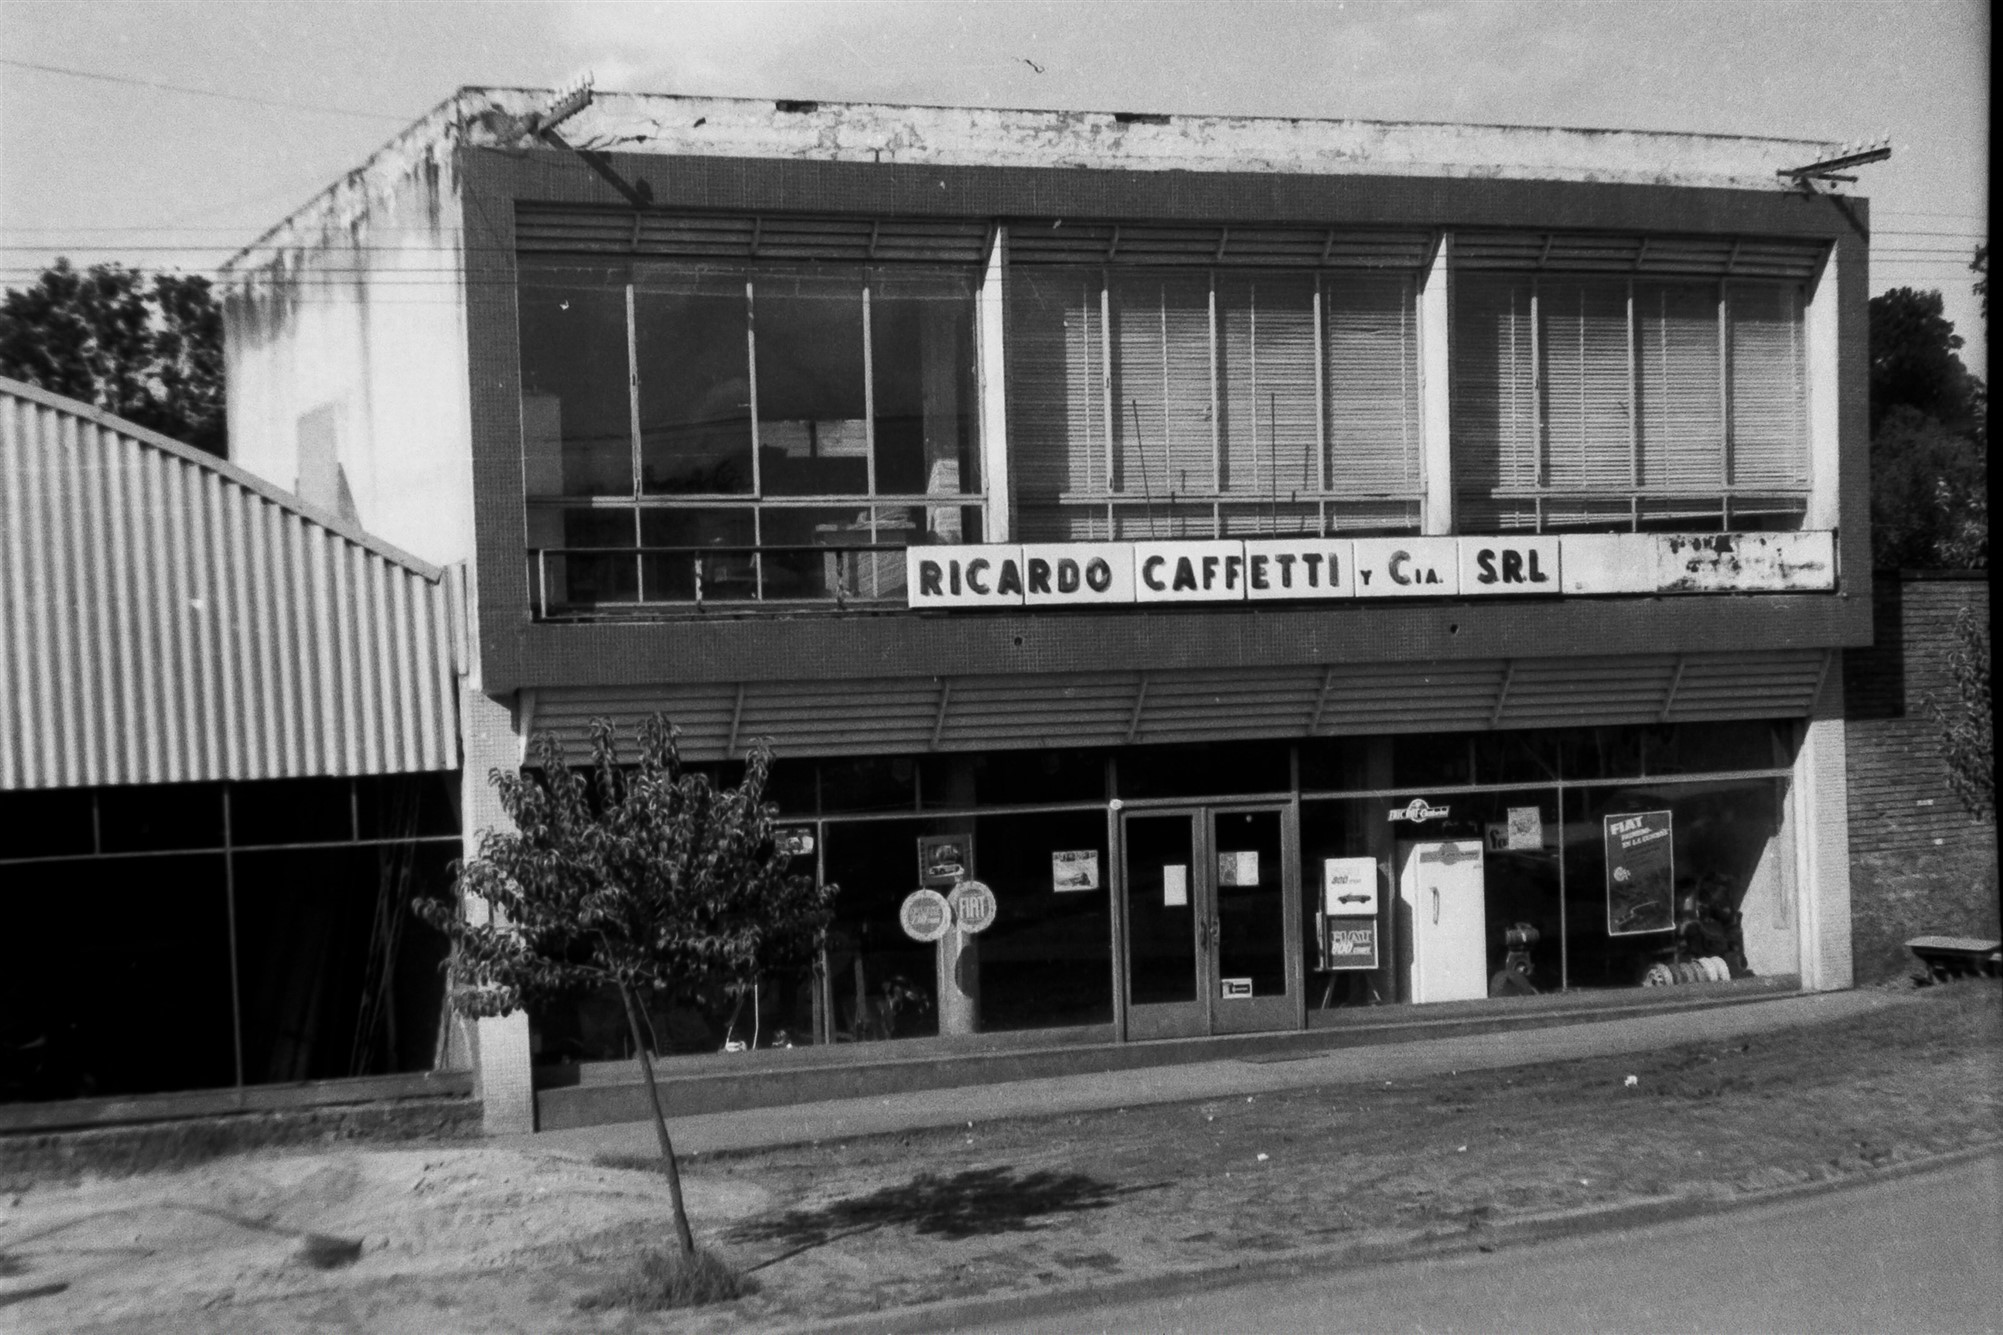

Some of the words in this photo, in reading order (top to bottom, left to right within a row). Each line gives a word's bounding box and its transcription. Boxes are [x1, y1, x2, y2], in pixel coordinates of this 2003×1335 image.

[919, 557, 1113, 596] RICARDO
[1142, 552, 1339, 592] CAFFETTI
[1610, 816, 1643, 835] FIAT
[959, 896, 985, 919] FIAT
[1331, 930, 1371, 943] FIAT
